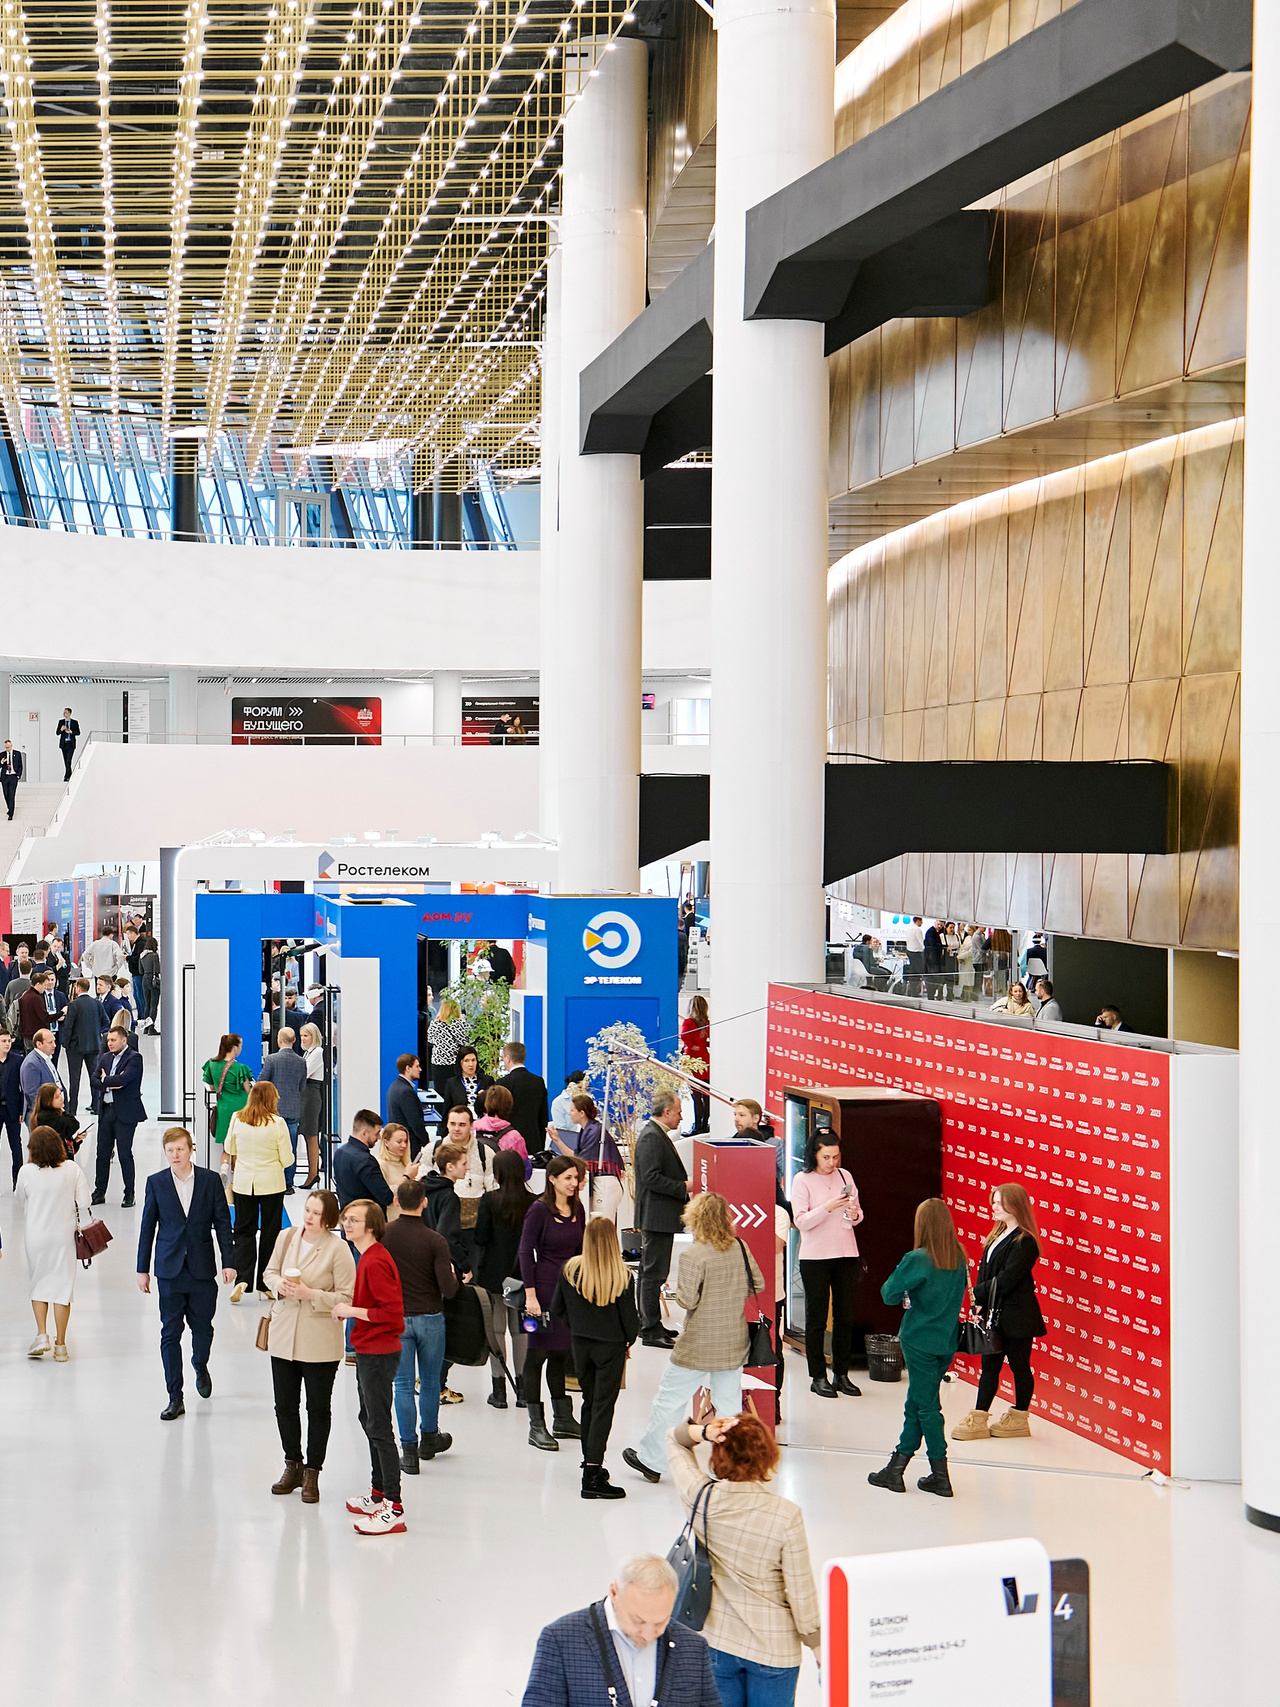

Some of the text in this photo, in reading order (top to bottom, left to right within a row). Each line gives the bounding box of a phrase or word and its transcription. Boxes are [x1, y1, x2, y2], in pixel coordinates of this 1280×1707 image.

[243, 706, 282, 717] ФОРУМ
[338, 863, 430, 877] Ростелеком
[1054, 1593, 1074, 1621] 4
[870, 1615, 908, 1627] БАЛКОН
[870, 1645, 937, 1658] Конференц-зал
[870, 1678, 913, 1689] Ресторан
